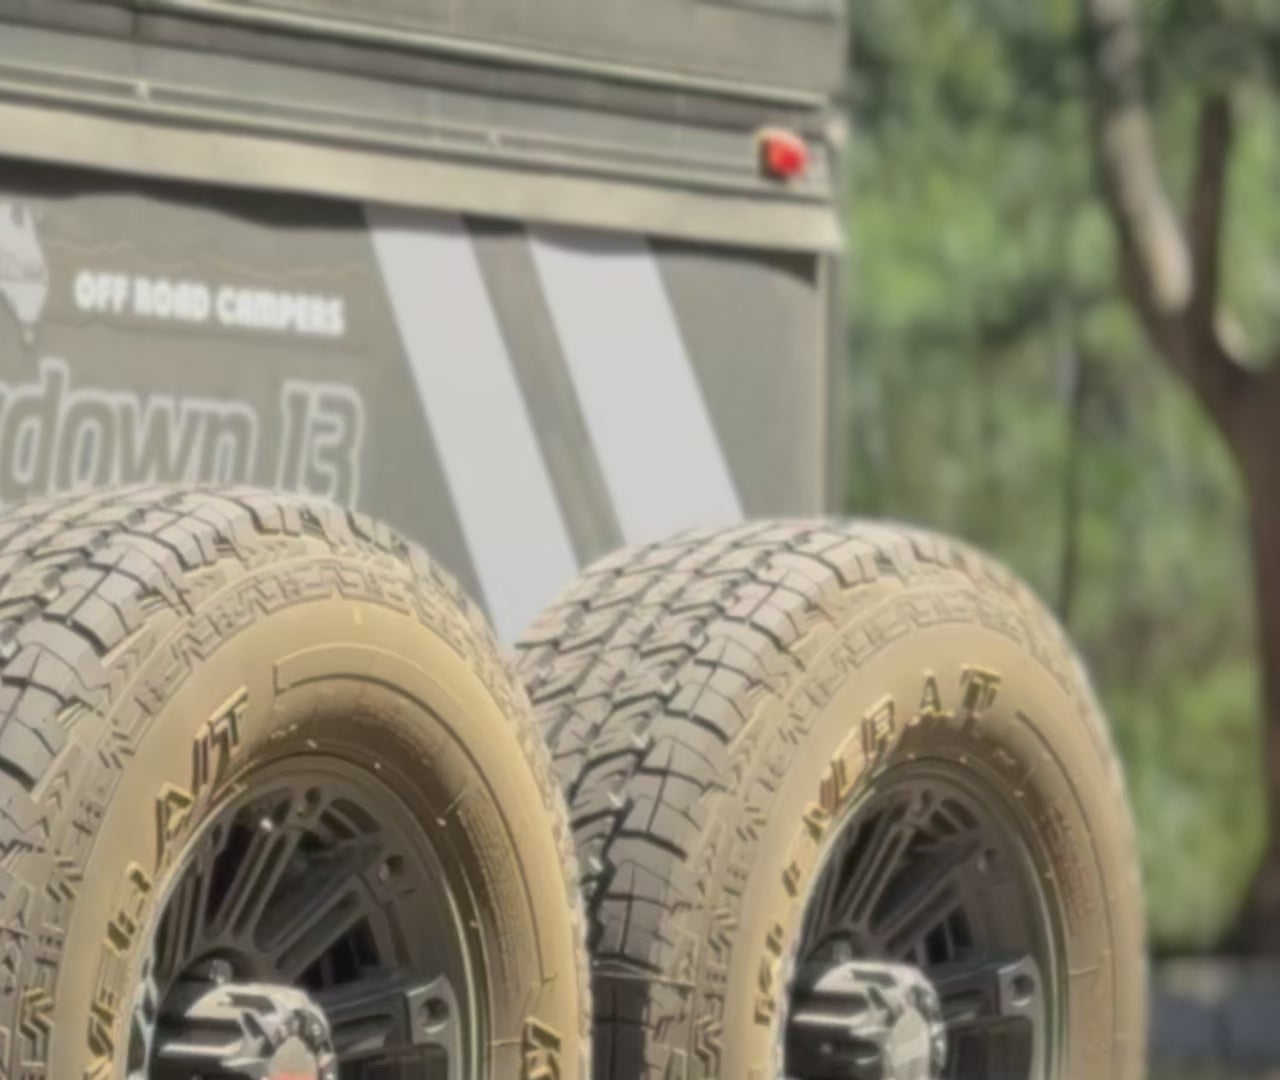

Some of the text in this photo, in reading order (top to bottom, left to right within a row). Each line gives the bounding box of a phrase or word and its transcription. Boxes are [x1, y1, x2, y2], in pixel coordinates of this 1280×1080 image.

[74, 271, 346, 336] OFF ROAD CAMPERS
